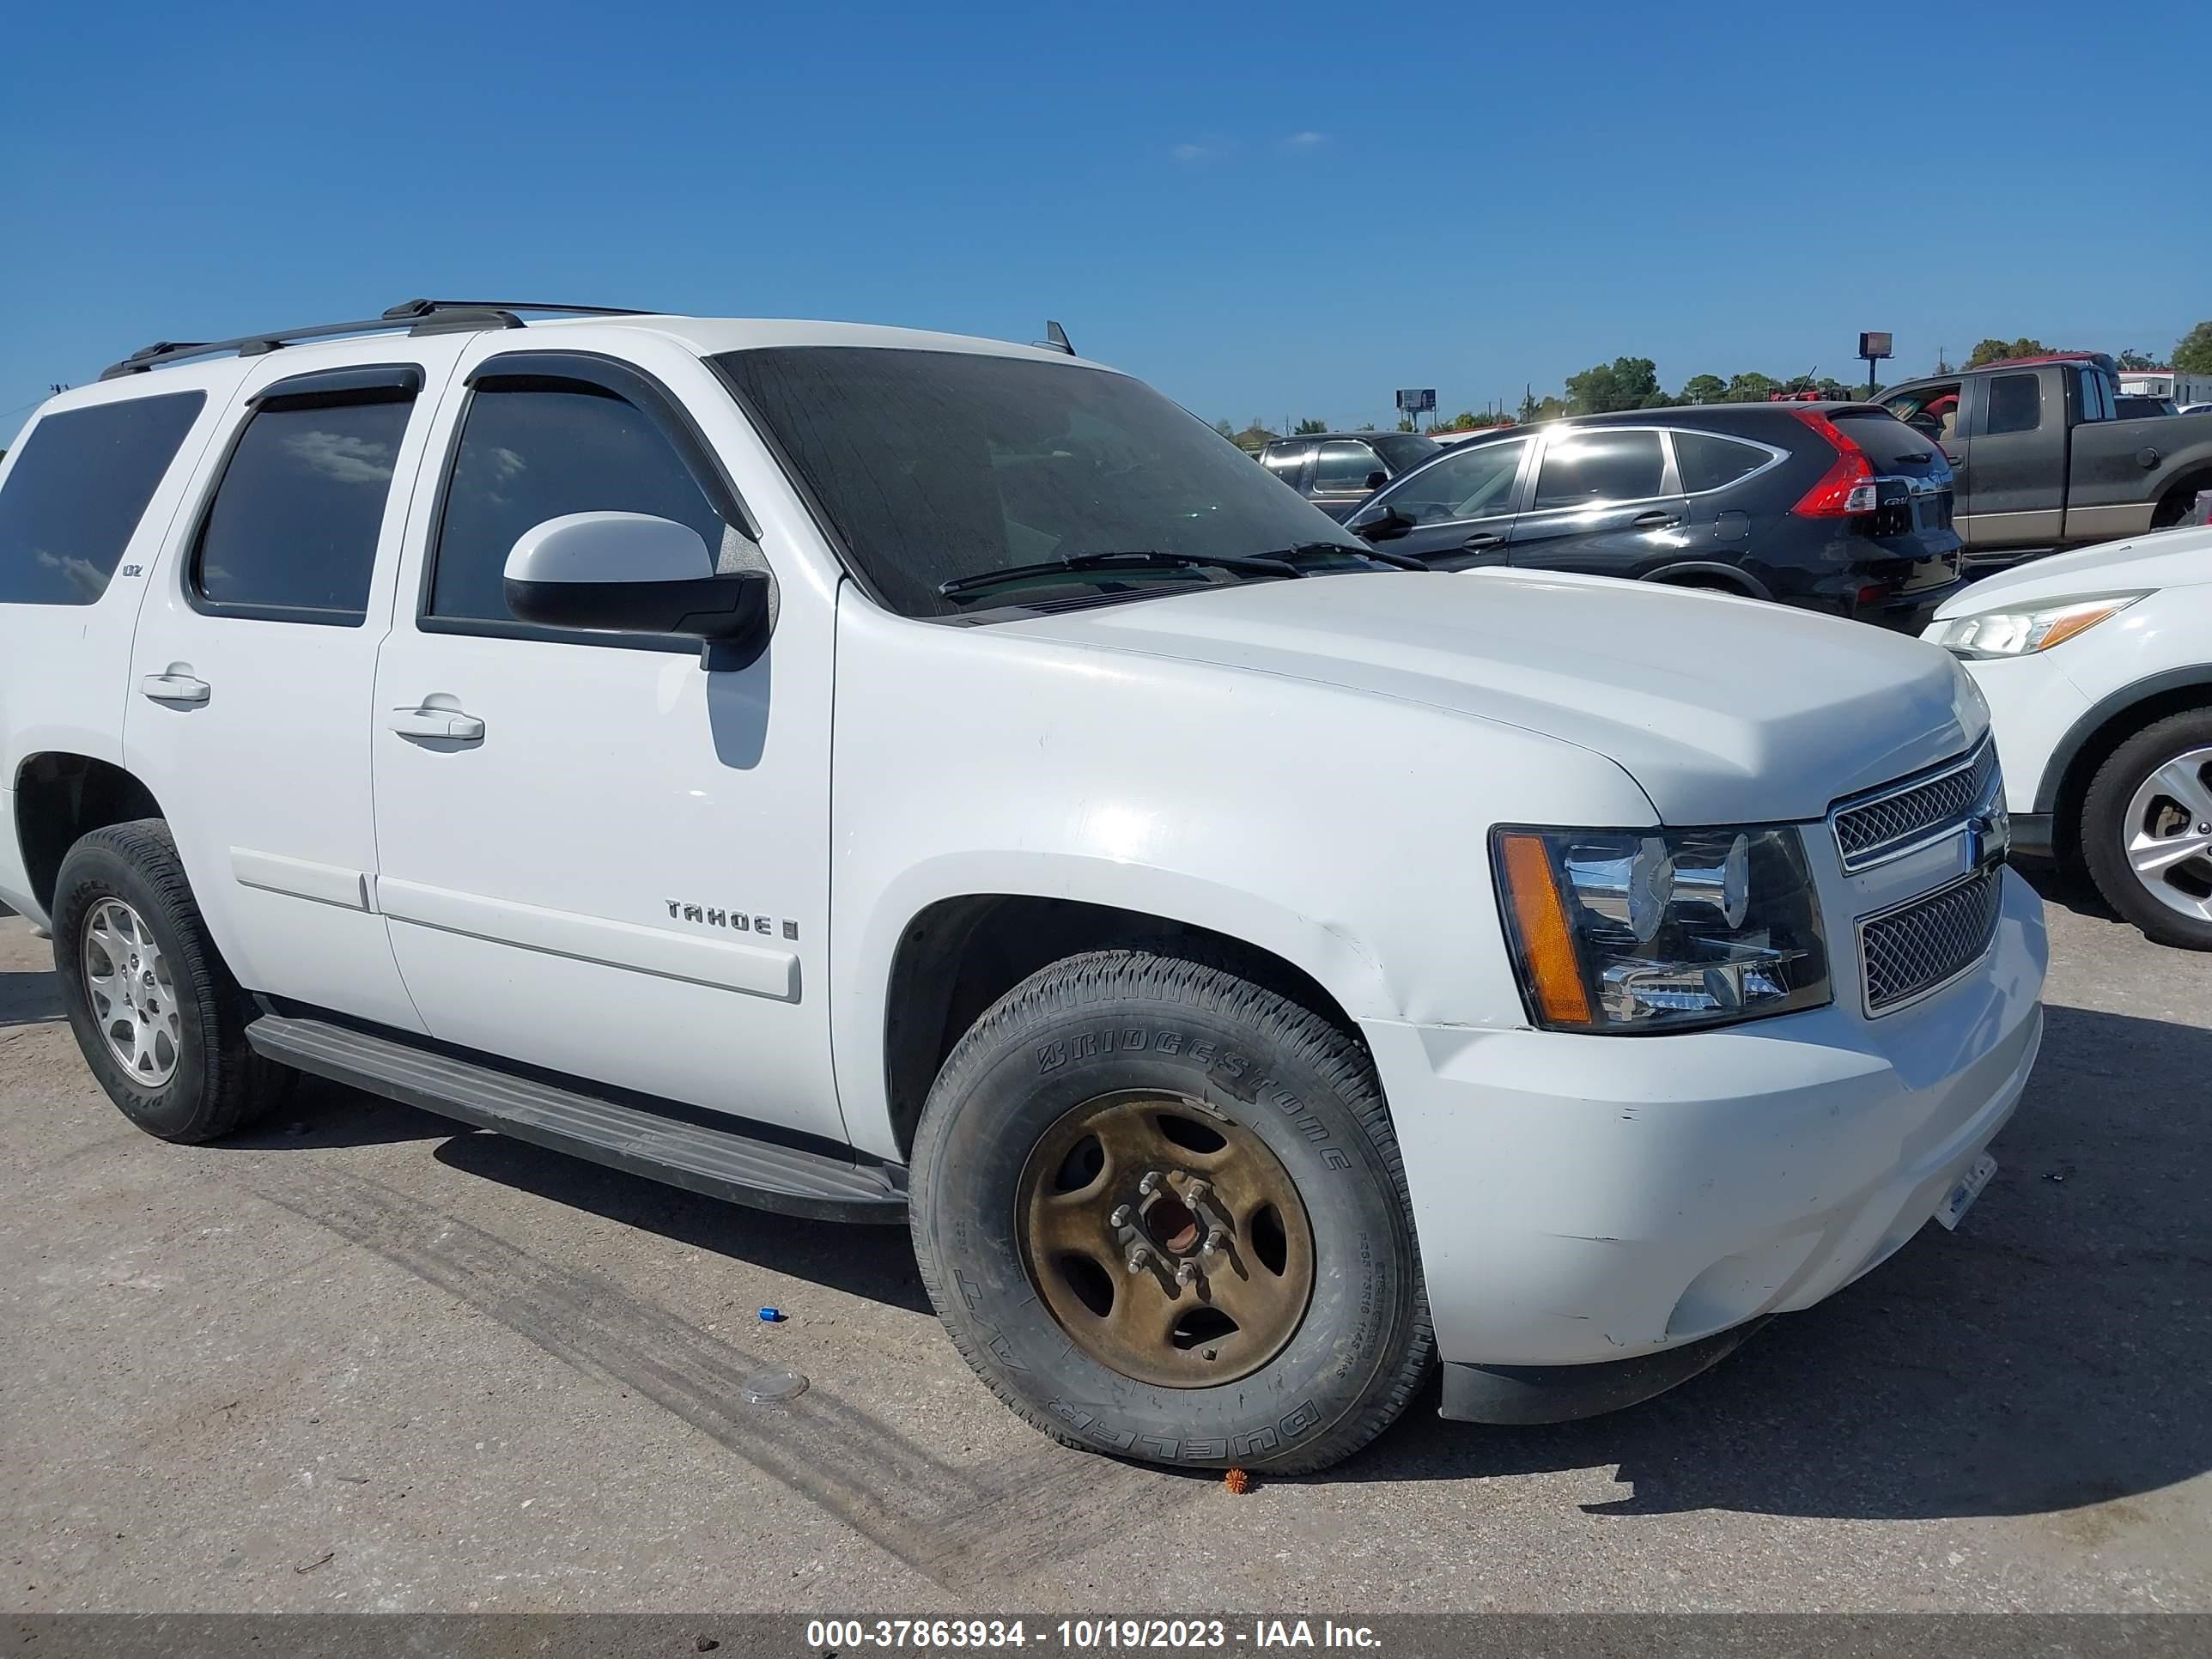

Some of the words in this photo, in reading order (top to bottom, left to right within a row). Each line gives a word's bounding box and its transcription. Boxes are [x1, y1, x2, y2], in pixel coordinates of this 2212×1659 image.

[665, 898, 772, 936] TAHOE
[1036, 1027, 1352, 1172] BRIDGESTONE
[953, 1268, 1031, 1372] A/T
[1047, 1395, 1322, 1461] DUELER
